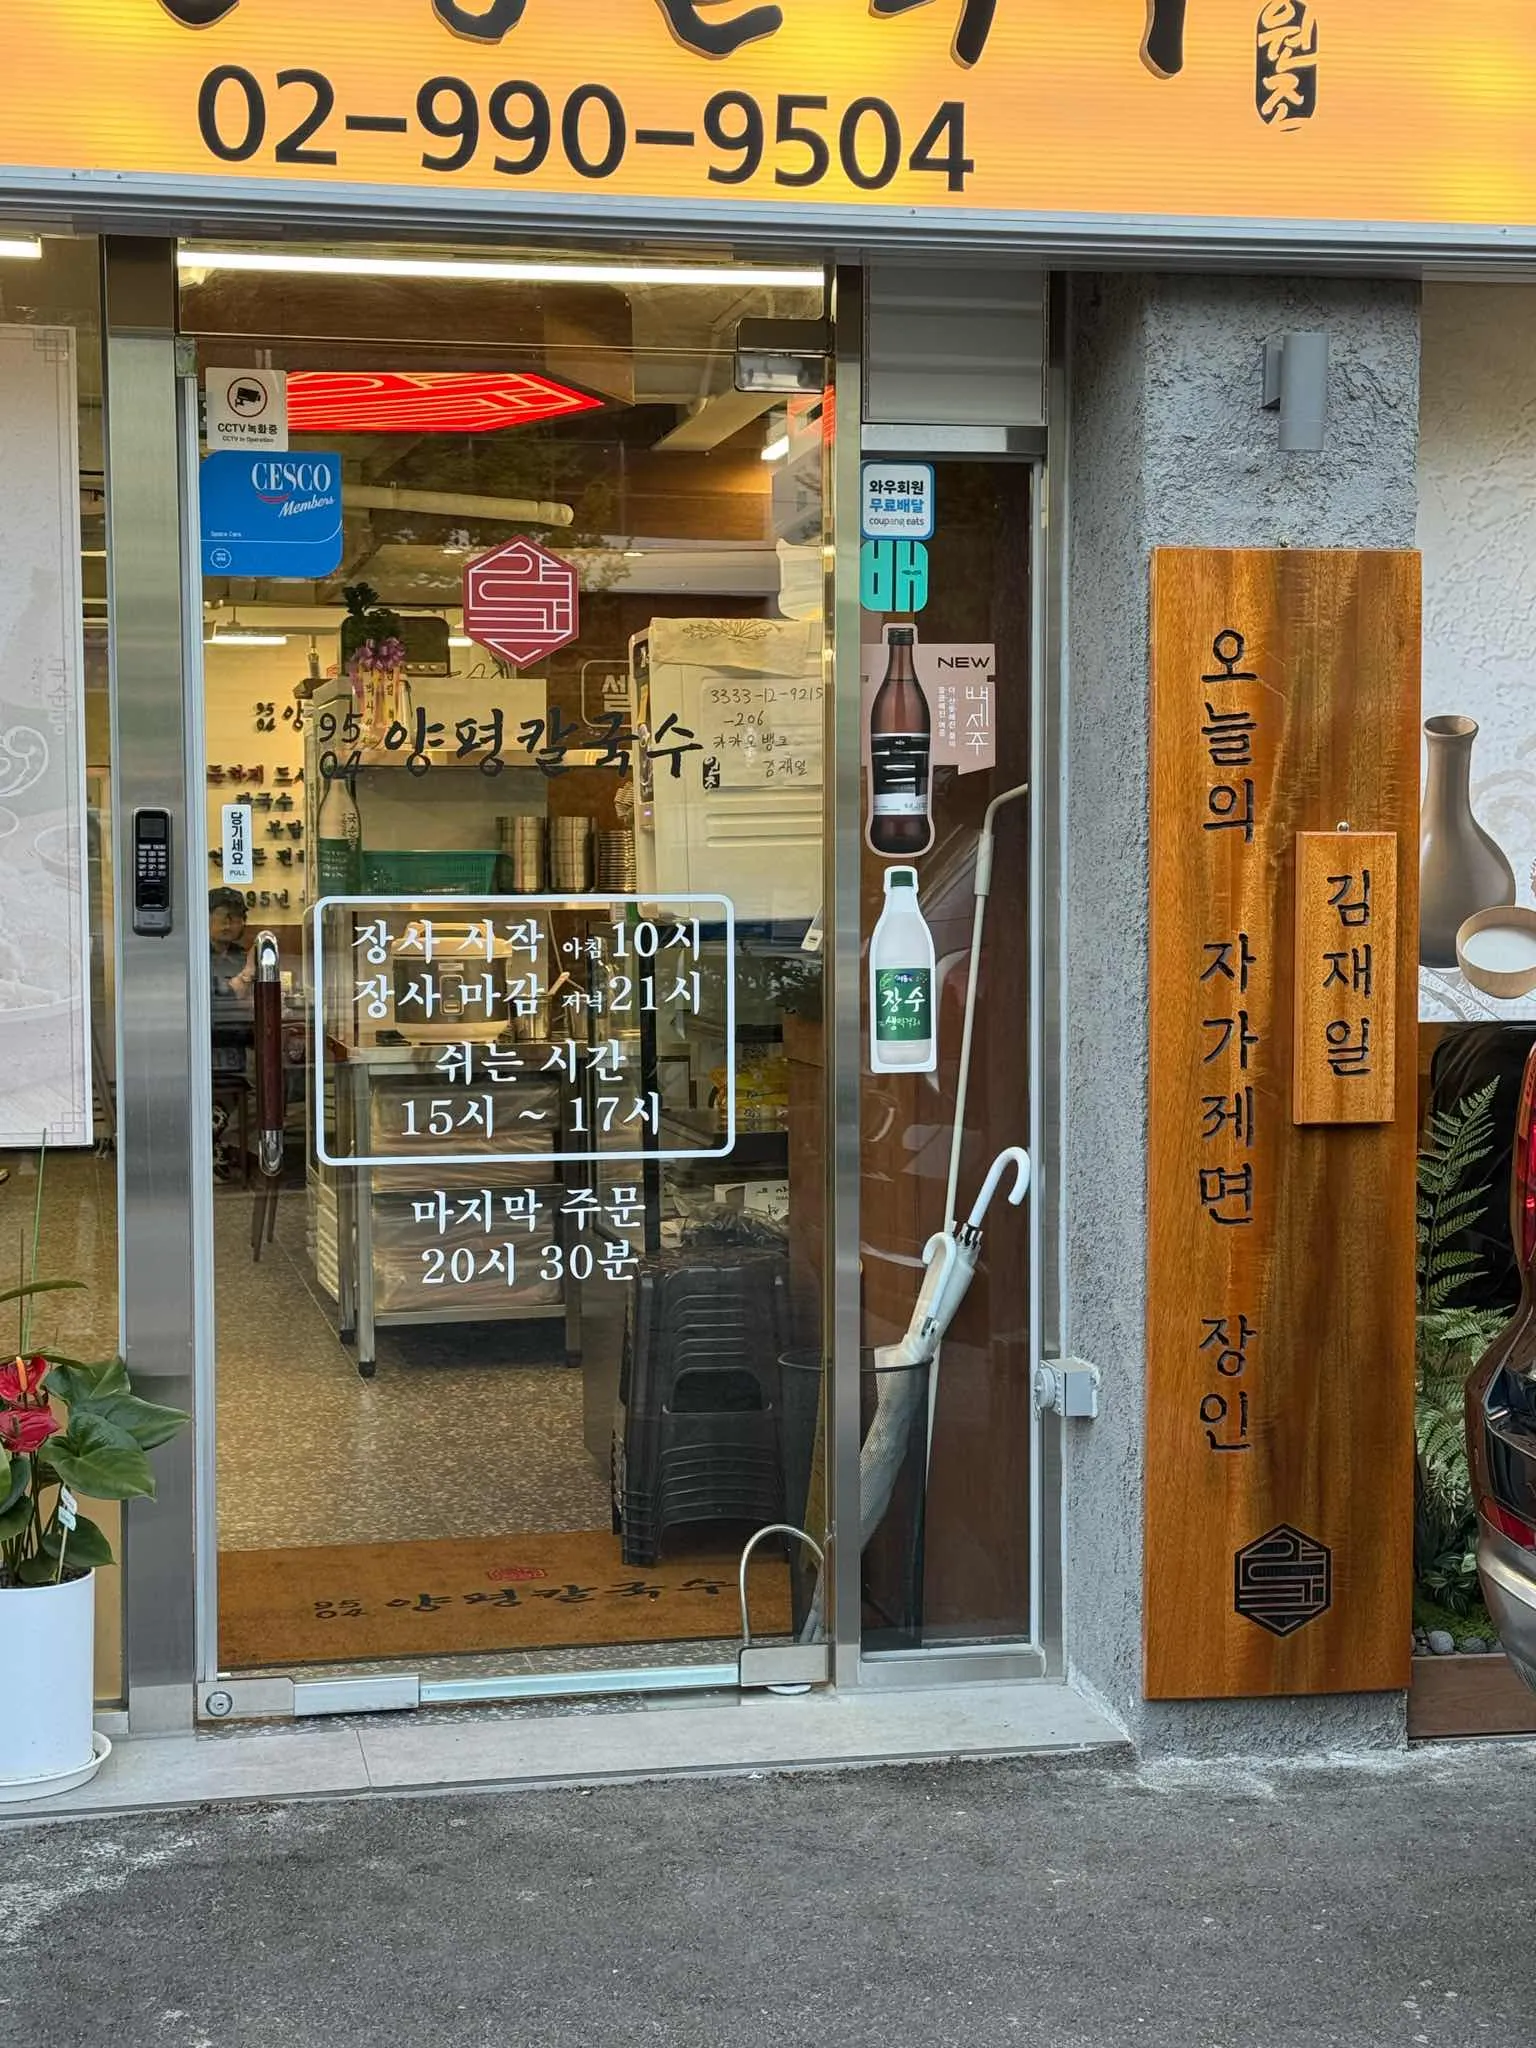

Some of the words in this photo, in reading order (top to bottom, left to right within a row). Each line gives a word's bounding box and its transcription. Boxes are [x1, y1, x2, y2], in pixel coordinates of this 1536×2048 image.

[1256, 0, 1319, 133] 원조
[198, 64, 975, 193] 02-990-9504
[217, 422, 246, 433] CCTV
[251, 462, 331, 492] CESCO
[869, 480, 924, 496] 와우회원
[277, 493, 335, 519] Members
[868, 516, 906, 528] coupang
[906, 516, 925, 526] eats
[869, 498, 924, 514] 무료배달
[937, 656, 990, 669] NEW
[319, 712, 364, 743] 95
[723, 712, 764, 727] -206
[1199, 628, 1258, 845] 오늘의
[384, 705, 705, 779] 양평칼국수
[319, 750, 365, 780] 04
[230, 811, 244, 866] 당기세요
[229, 869, 248, 877] PULL
[351, 918, 440, 965] 장사
[456, 918, 545, 964] 시작
[562, 936, 602, 961] 아침
[611, 918, 701, 962] 10시
[1322, 869, 1374, 1078] 김재일
[352, 973, 441, 1019] 장사
[458, 972, 545, 1015] 마감
[561, 989, 603, 1014] 저녁
[608, 970, 702, 1016] 21시
[881, 985, 926, 1013] 장수
[434, 1041, 525, 1086] 쉬는
[539, 1039, 627, 1084] 시간
[1199, 932, 1259, 1226] 자가제면
[400, 1094, 494, 1139] 15시
[568, 1091, 661, 1136] 17시
[411, 1188, 543, 1235] 마지막
[560, 1186, 647, 1231] 주문
[421, 1242, 516, 1287] 20시
[540, 1240, 640, 1281] 30분
[1198, 1312, 1258, 1453] 장인
[313, 1598, 361, 1611] 95
[385, 1578, 738, 1613] 양평칼국수
[315, 1608, 368, 1619] 04
